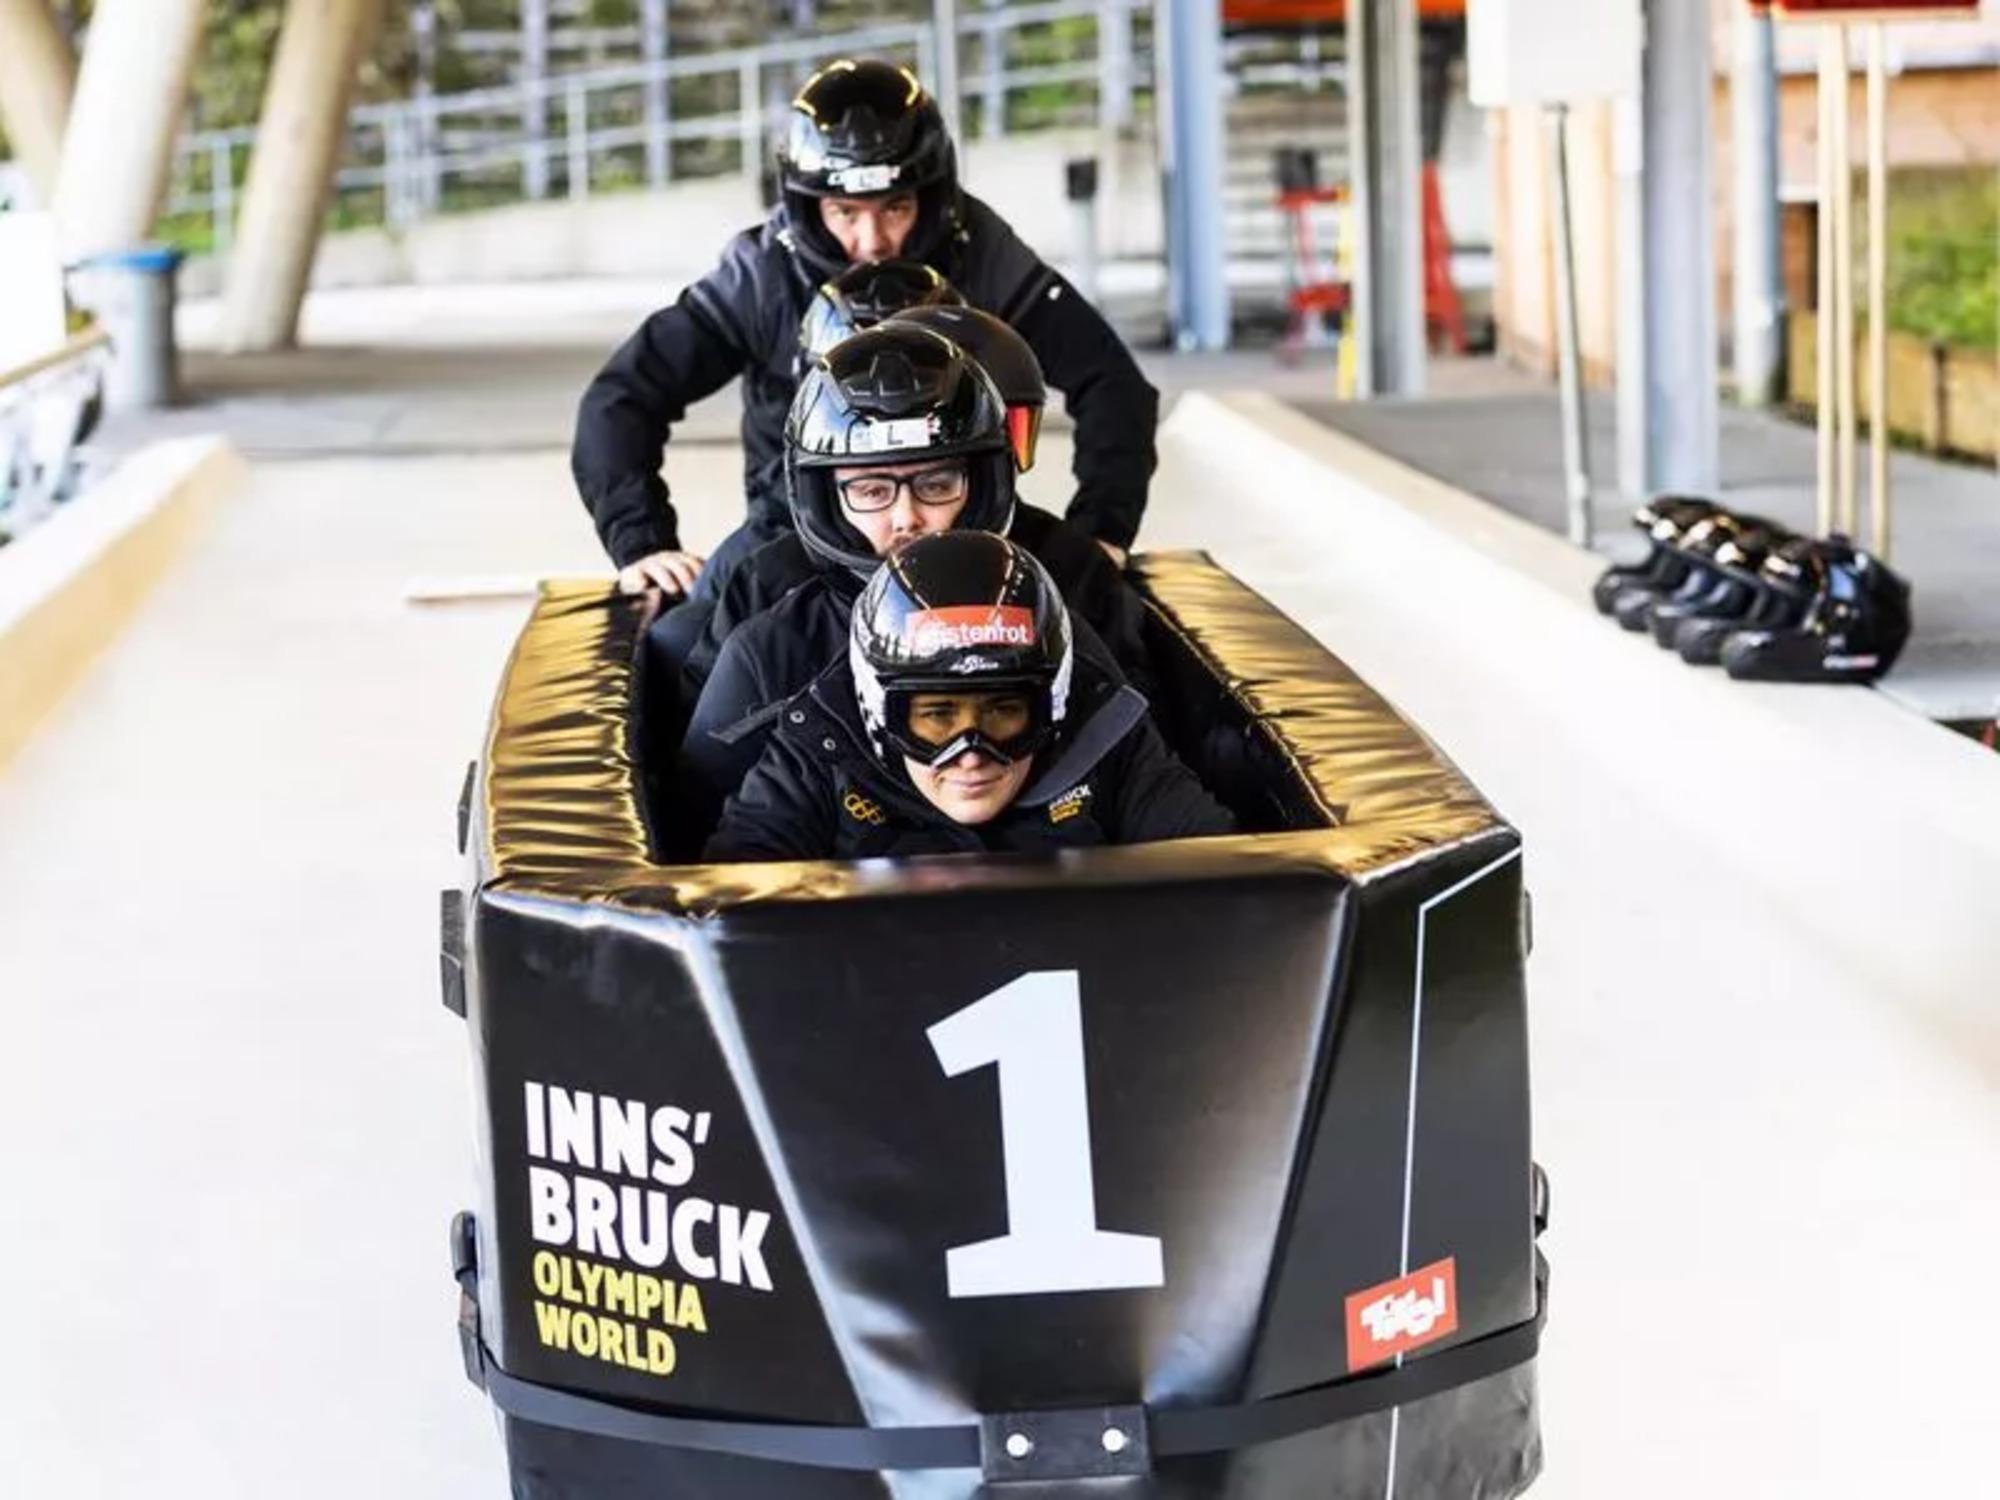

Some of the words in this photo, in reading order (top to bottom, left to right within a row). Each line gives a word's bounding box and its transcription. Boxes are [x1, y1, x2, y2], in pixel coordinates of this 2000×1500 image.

[525, 1081, 711, 1186] INNS'
[926, 970, 1164, 1298] 1
[529, 1165, 773, 1291] BRUCK
[534, 1251, 707, 1332] OLYMPIA
[535, 1300, 676, 1375] WORLD
